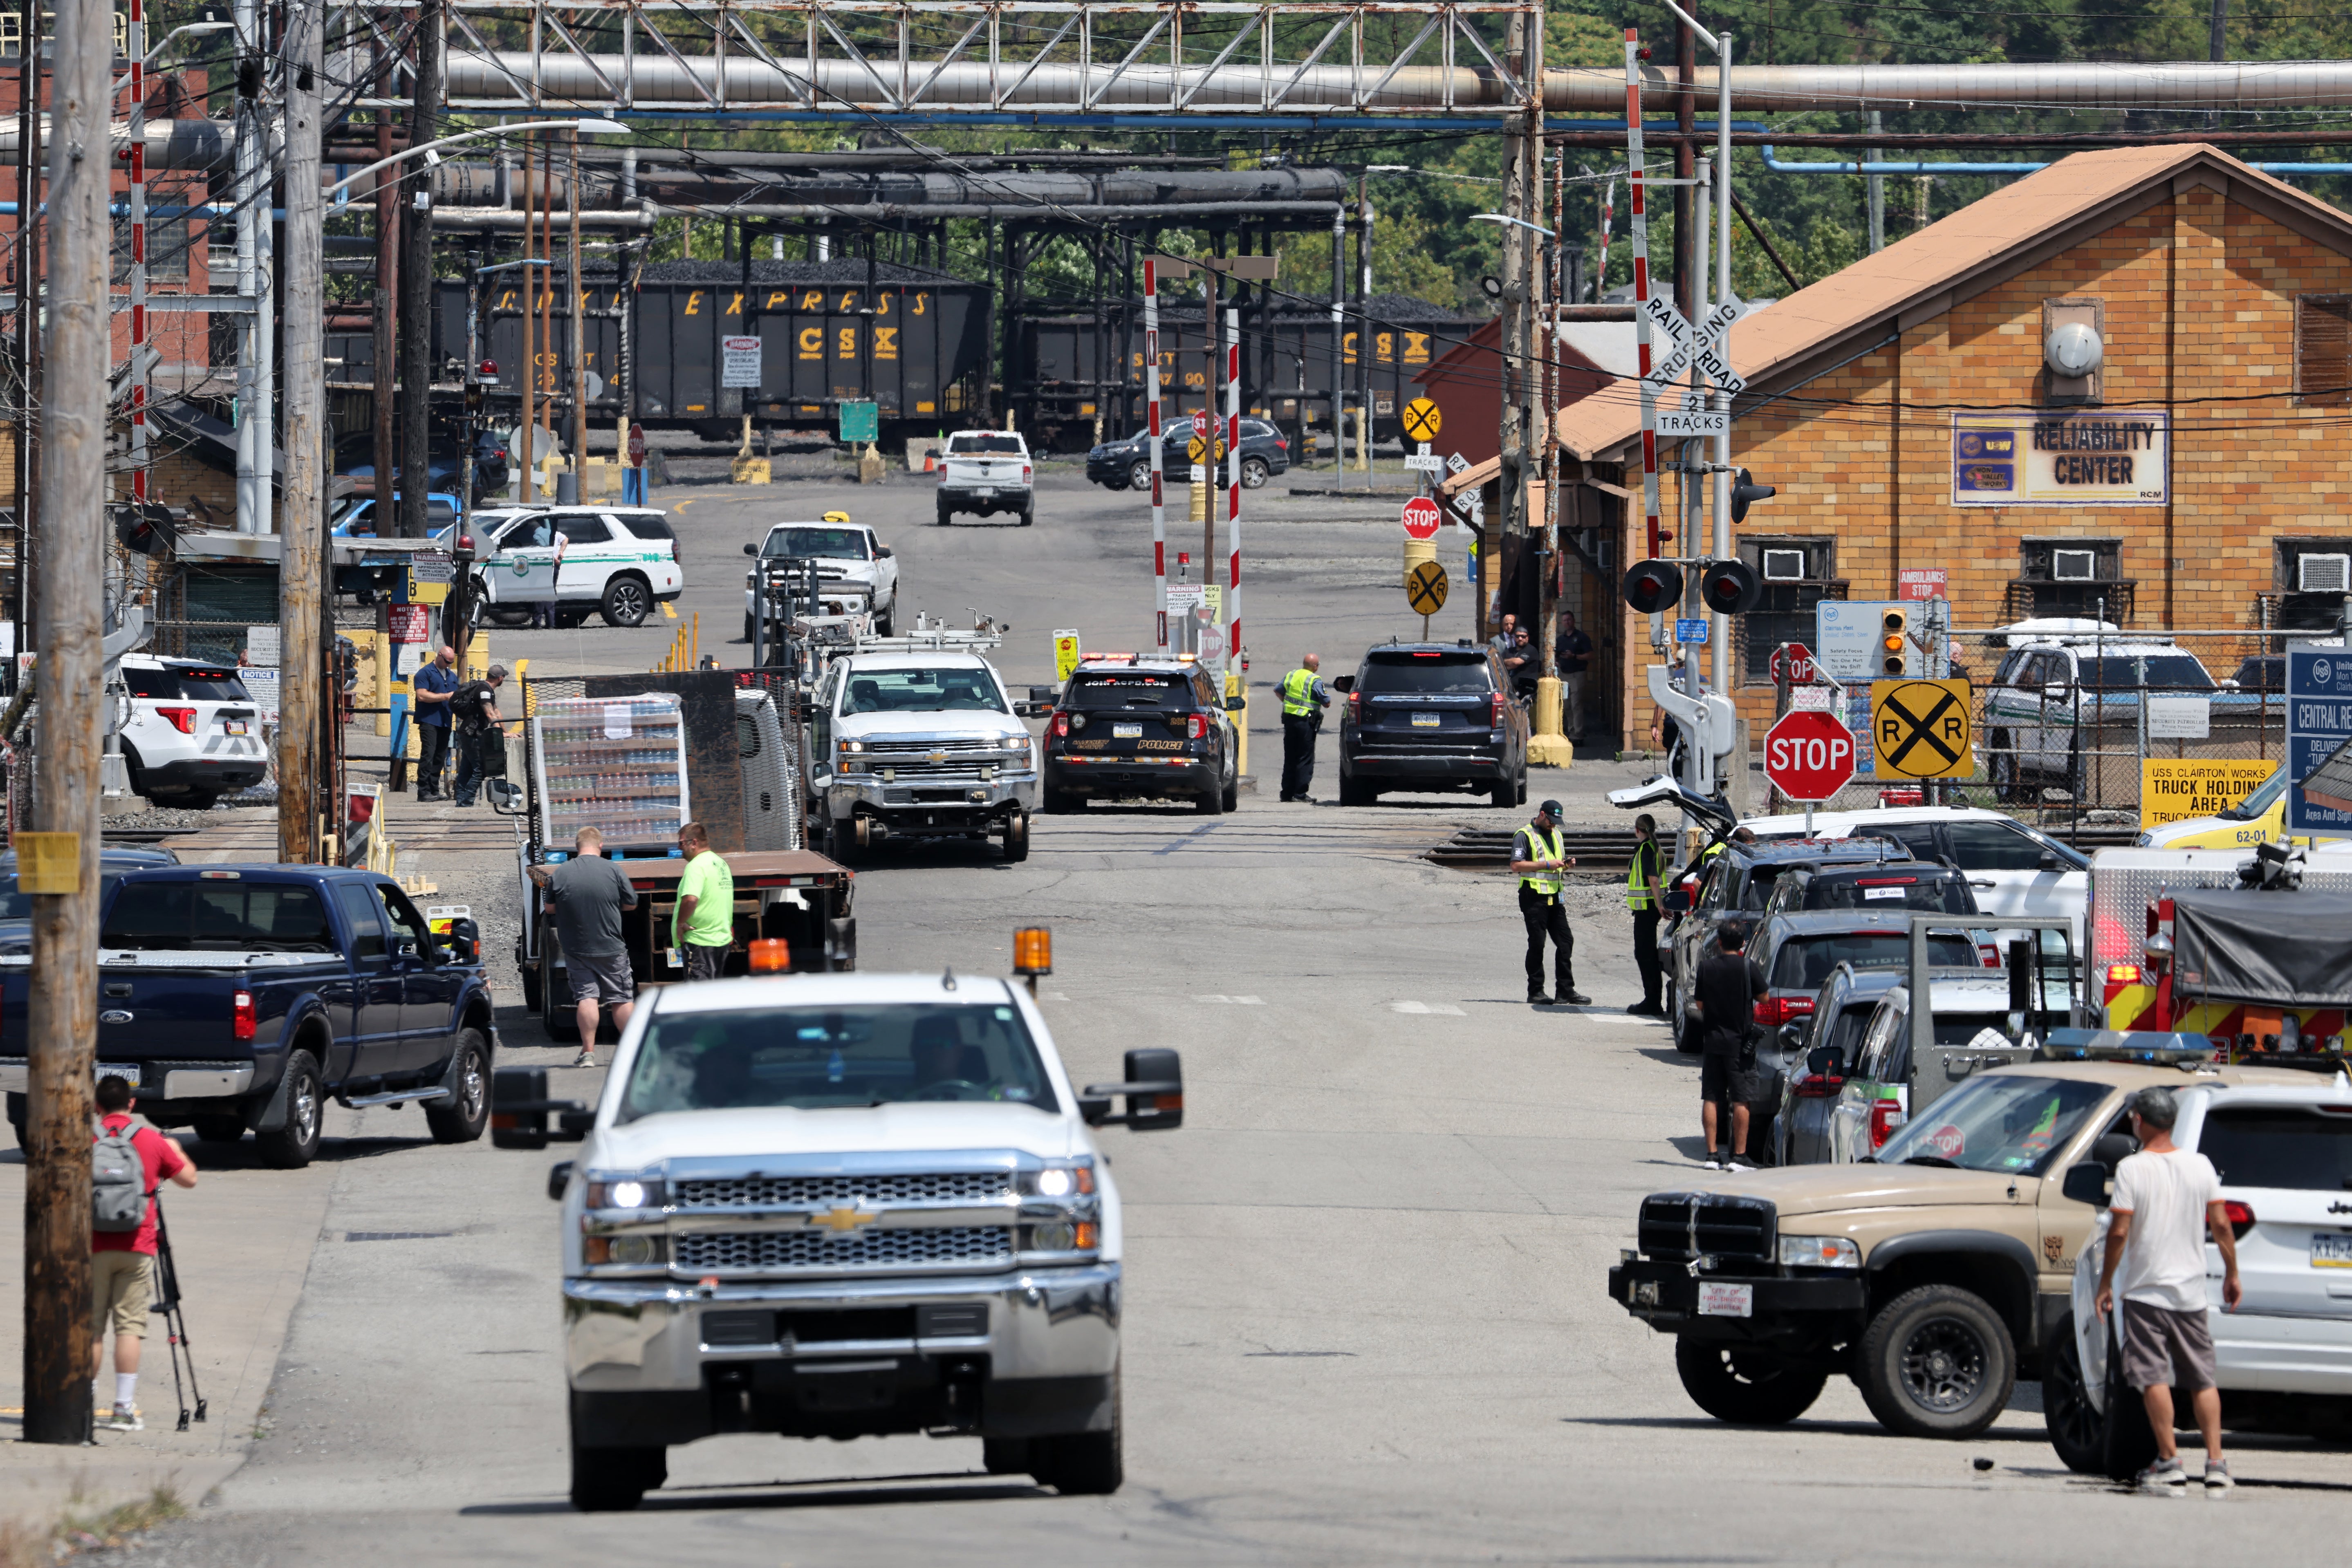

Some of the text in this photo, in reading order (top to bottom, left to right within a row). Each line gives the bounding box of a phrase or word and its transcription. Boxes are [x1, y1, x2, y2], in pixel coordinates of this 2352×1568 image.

[684, 290, 929, 315] EXPRESS
[799, 327, 898, 354] CSX
[1342, 332, 1430, 358] CSX
[1646, 297, 1742, 395] RAIL ROAD
[1688, 395, 1698, 412] 2
[1194, 418, 1219, 429] STP
[1406, 412, 1438, 425] R R
[1661, 417, 1723, 430] TRACKS
[2033, 422, 2155, 450] RELIABILITY
[630, 437, 643, 454] STOP
[1421, 446, 1426, 455] 2
[1409, 458, 1438, 467] TRACKS
[1450, 456, 1466, 473] RA
[2055, 456, 2133, 484] CENTER
[1404, 508, 1438, 527] STOP
[1901, 571, 1945, 583] AMBULANCE
[1410, 580, 1446, 596] R R
[1911, 584, 1933, 597] STOP
[1202, 636, 1222, 650] TOP
[1773, 659, 1813, 679] SOP
[2315, 665, 2329, 678] USS
[2336, 671, 2349, 680] Mon
[2299, 703, 2339, 729] CENTRAL
[1882, 717, 1963, 743] R R
[1137, 740, 1184, 750] POLICE
[1771, 738, 1849, 771] STOP
[2152, 767, 2266, 779] USS CLAIRTON WORKS
[2153, 780, 2198, 795] TRUCK
[2190, 797, 2228, 811] AREA
[2305, 809, 2321, 821] Area
[2322, 809, 2336, 821] And
[2236, 830, 2267, 843] 62-01
[107, 1013, 124, 1022] Ford
[1926, 1135, 1962, 1152] STOP
